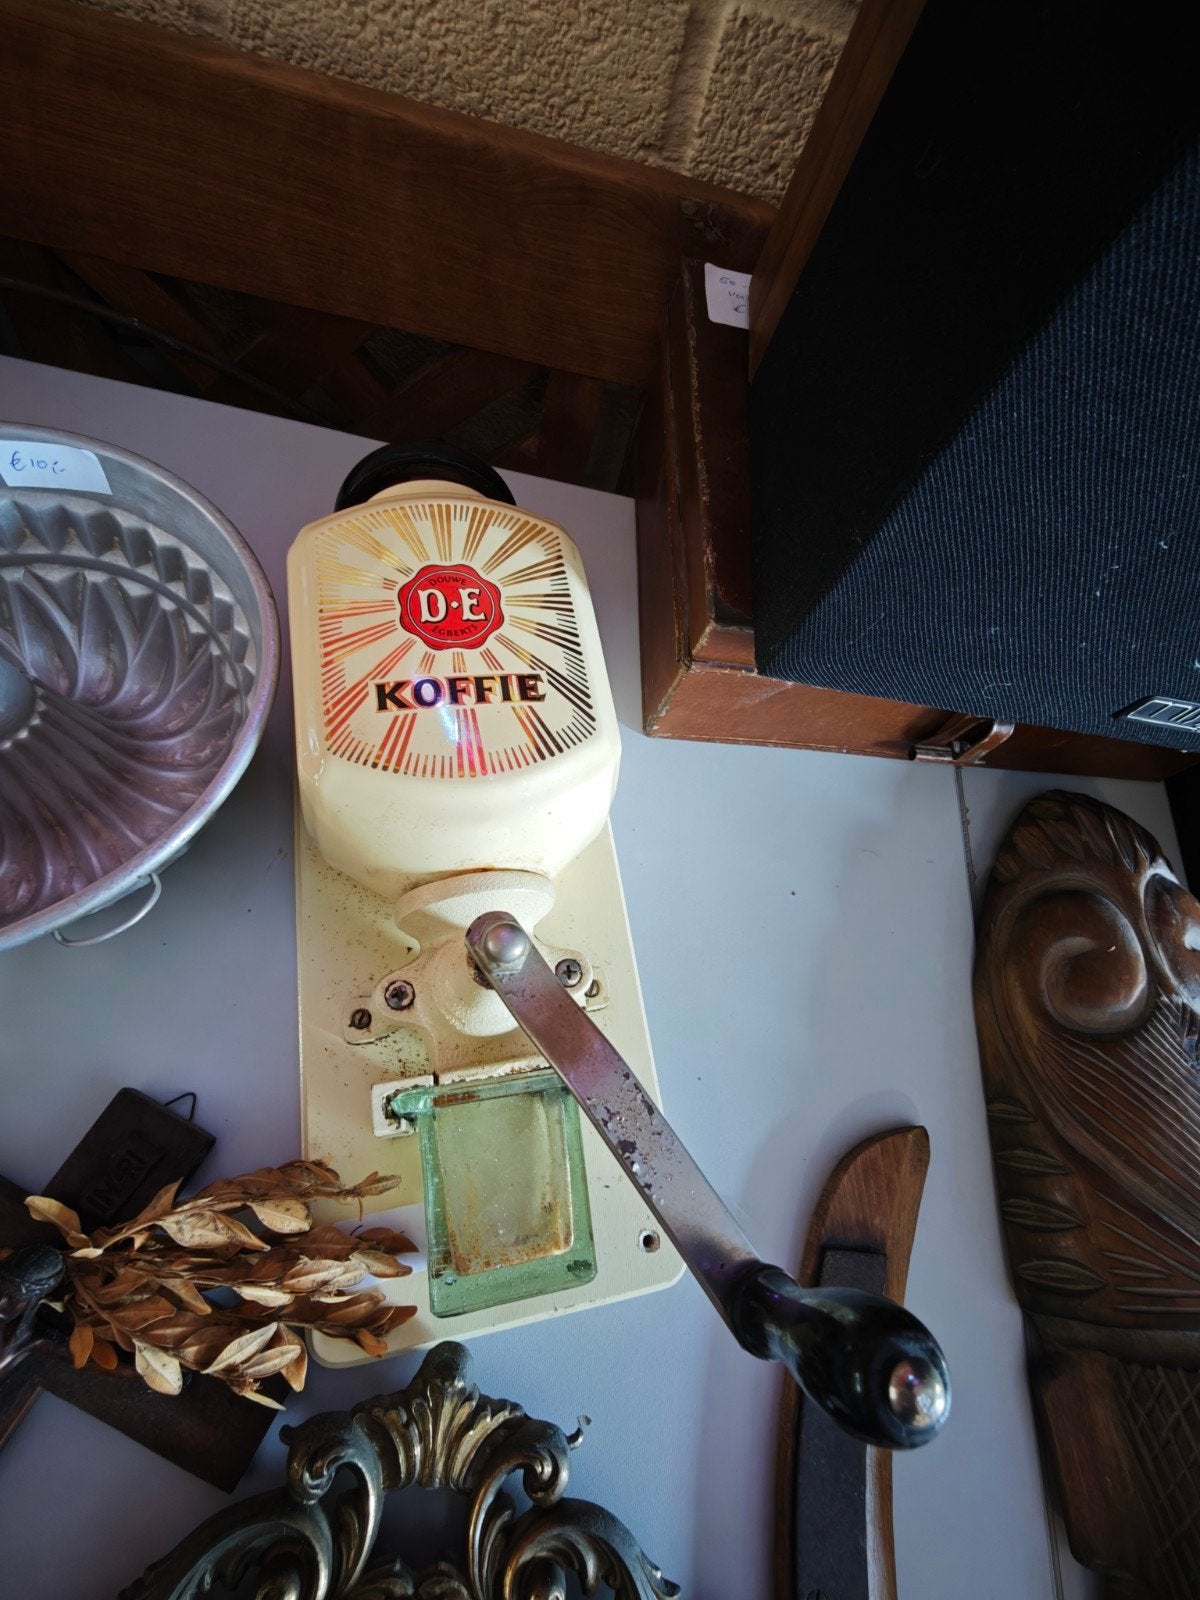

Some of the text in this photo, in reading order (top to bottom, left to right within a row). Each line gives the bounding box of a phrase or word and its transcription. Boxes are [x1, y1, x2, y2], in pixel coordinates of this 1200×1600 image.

[429, 575, 467, 587] DOUWE
[431, 623, 479, 637] EGBERTS
[376, 674, 547, 713] KOFFIE
